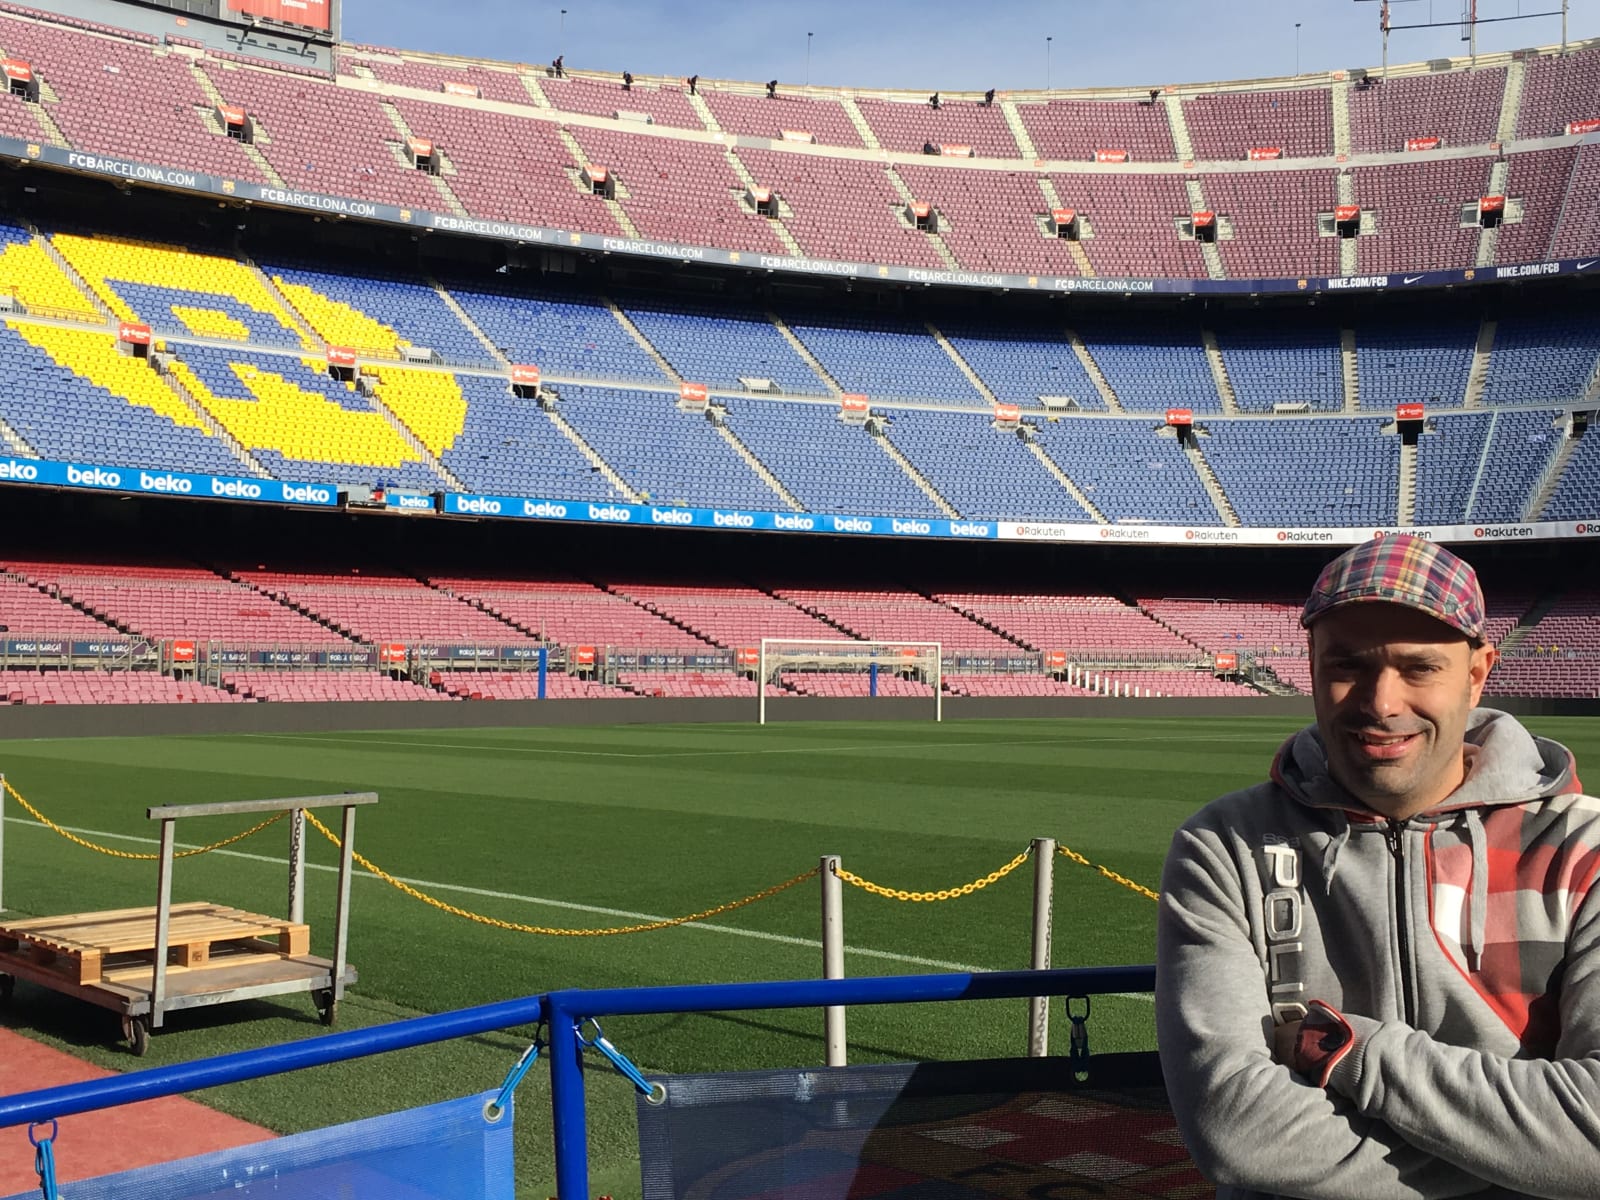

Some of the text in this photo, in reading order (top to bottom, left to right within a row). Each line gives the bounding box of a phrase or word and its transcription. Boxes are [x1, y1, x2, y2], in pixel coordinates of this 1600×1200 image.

[68, 153, 195, 187] FCBARCELONA.COM
[260, 188, 376, 217] FCBARCELONA.COM
[434, 216, 542, 241] FCBARCELONA.COM
[603, 238, 704, 260] FCBARCELONA.COM
[760, 256, 858, 275] FCBARCELONA.COM
[1497, 262, 1560, 279] NIKE.COM/FCB
[908, 269, 1003, 286] FCBARCELONA.COM
[1055, 279, 1153, 292] FCBARCELONA.COM
[1328, 276, 1388, 289] NIKE.COM/FCB
[0, 461, 37, 480] eko
[67, 465, 121, 487] beko
[140, 471, 192, 493] beko
[211, 477, 262, 498] beko
[282, 483, 330, 503] beko
[400, 495, 429, 508] beko
[457, 496, 501, 514] beko
[524, 499, 567, 518] beko
[588, 504, 631, 522] beko
[651, 508, 693, 525] beko
[713, 511, 754, 527] beko
[774, 514, 814, 530] beko
[833, 517, 873, 533] beko
[892, 519, 931, 535] beko
[950, 522, 989, 537] beko
[1484, 526, 1533, 538] Rakuten
